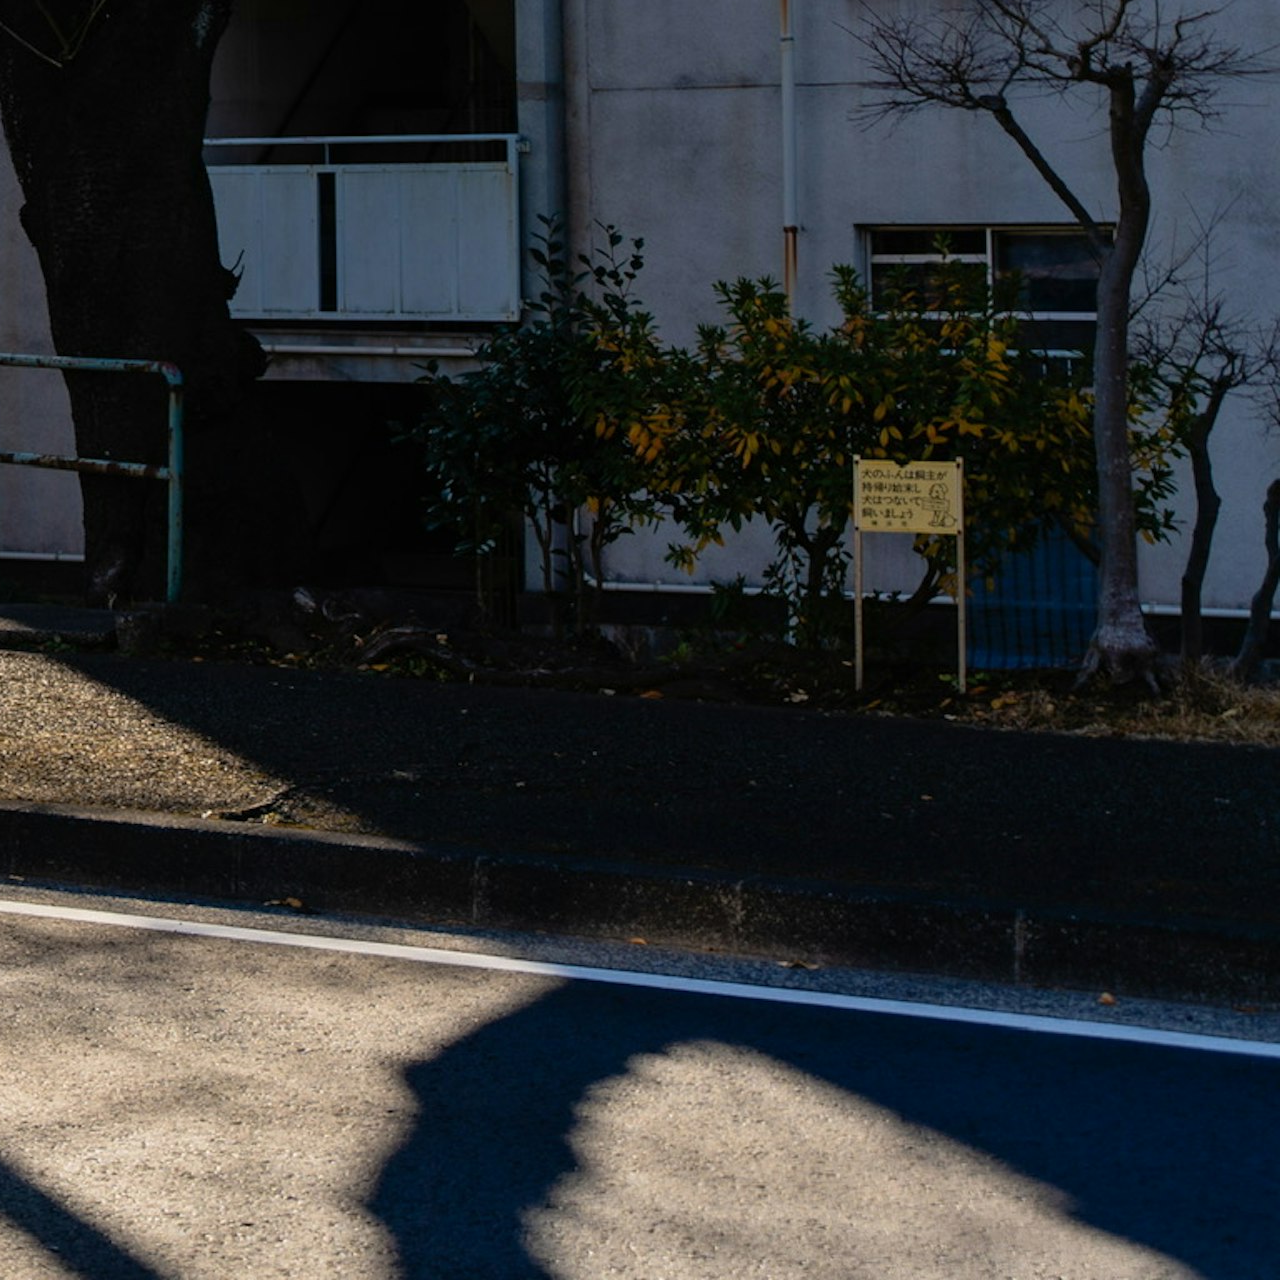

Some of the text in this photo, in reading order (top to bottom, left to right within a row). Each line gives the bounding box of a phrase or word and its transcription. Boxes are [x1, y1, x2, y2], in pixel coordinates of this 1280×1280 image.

[861, 507, 914, 519] 飼いましょう
